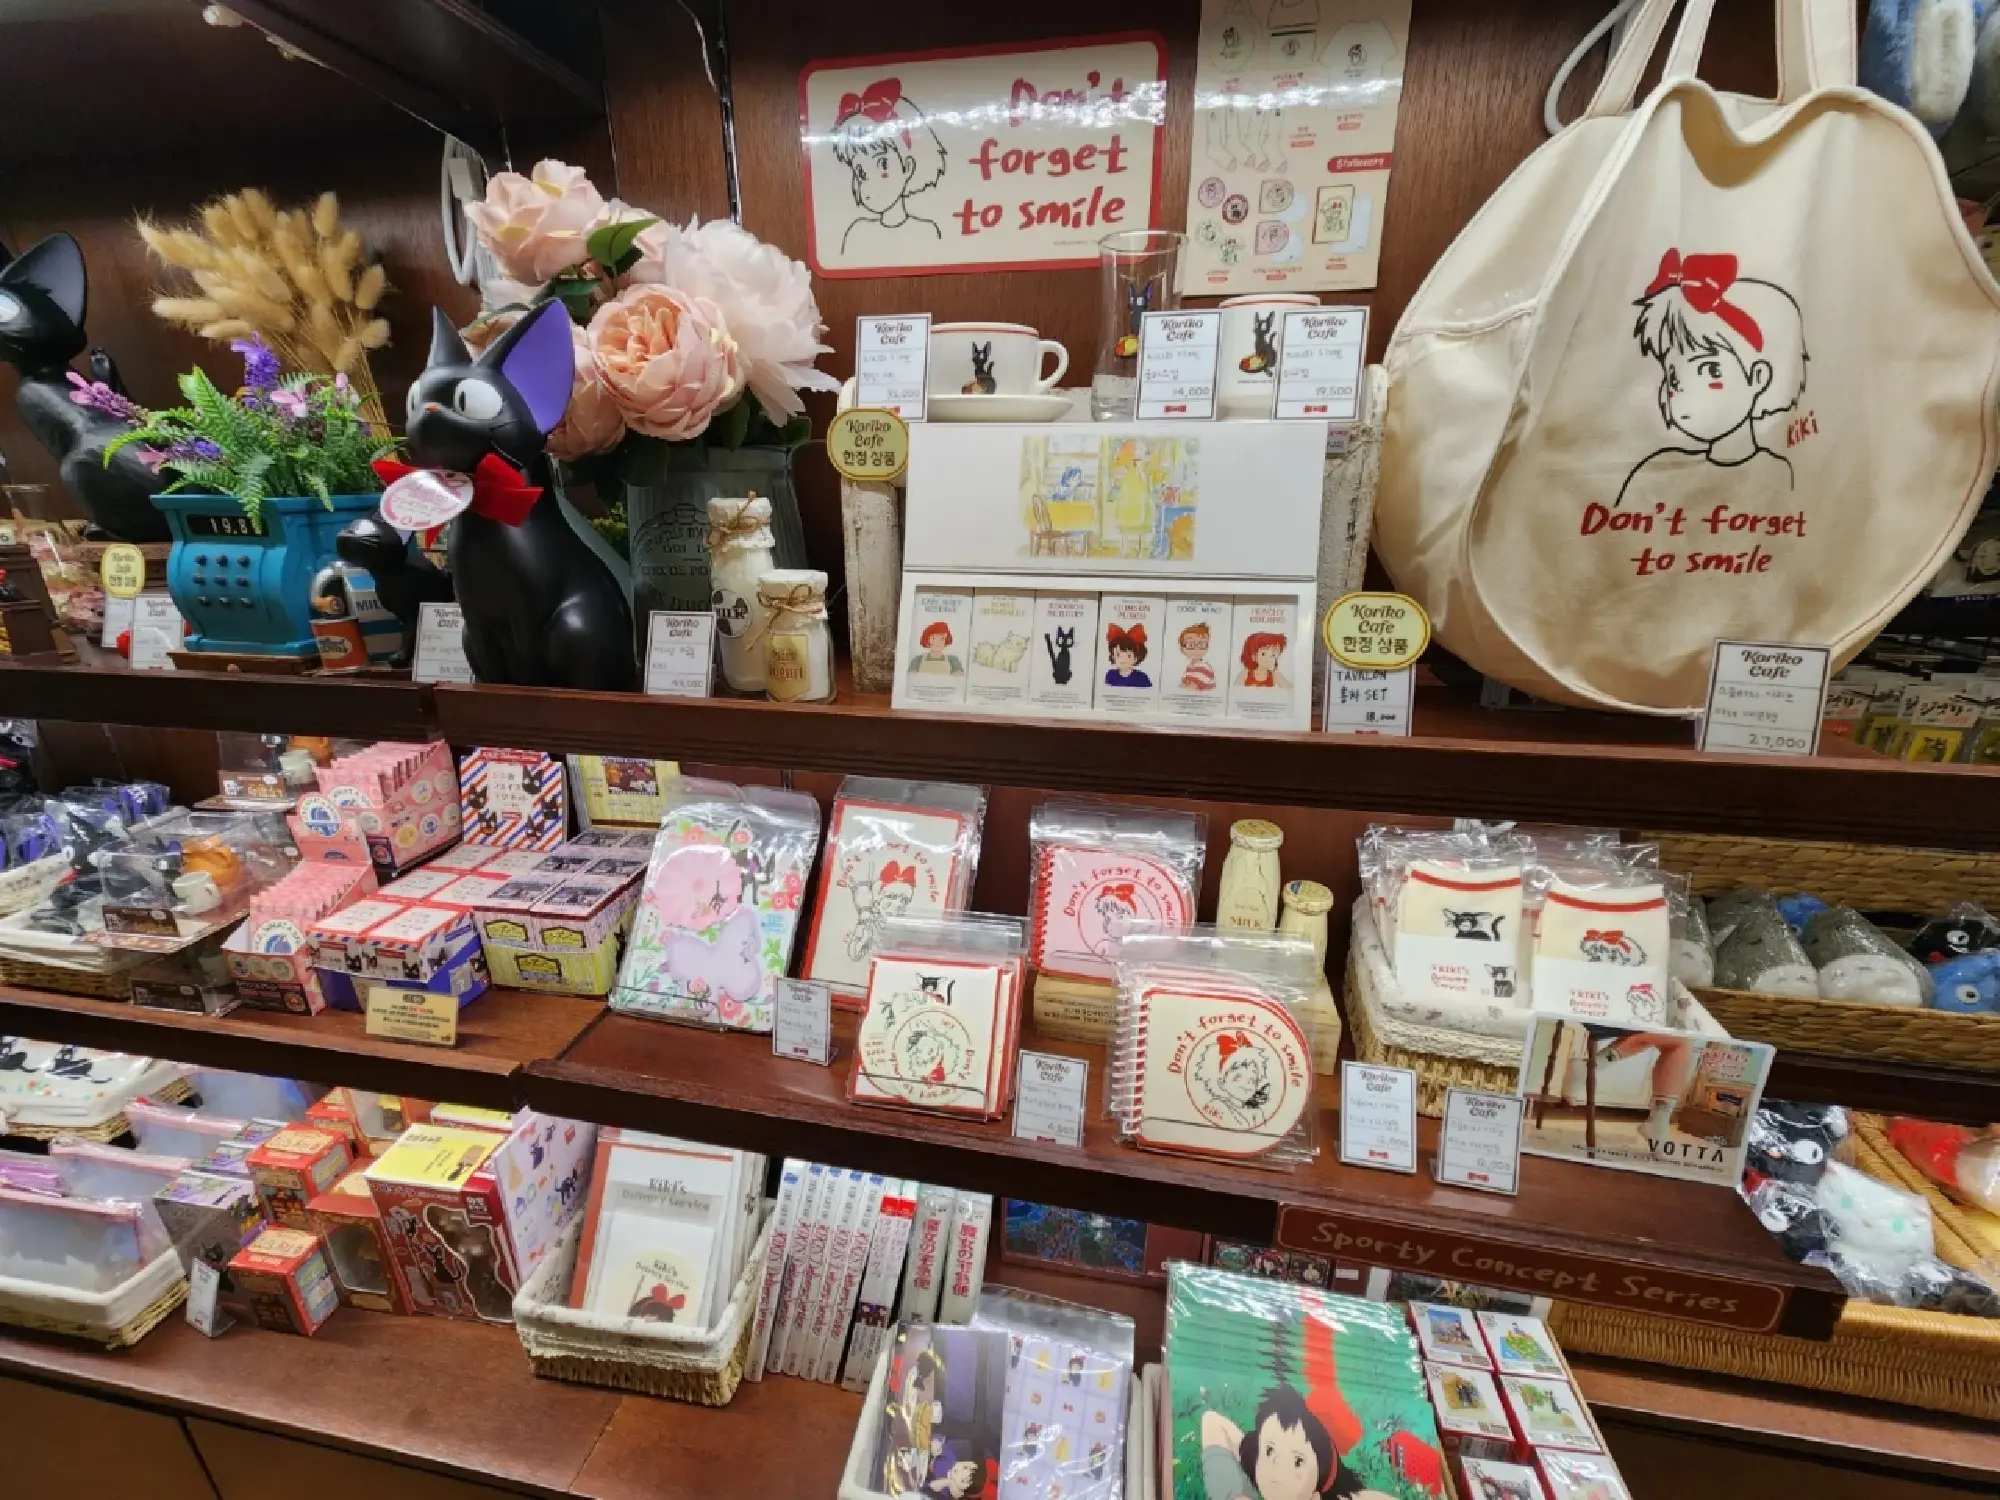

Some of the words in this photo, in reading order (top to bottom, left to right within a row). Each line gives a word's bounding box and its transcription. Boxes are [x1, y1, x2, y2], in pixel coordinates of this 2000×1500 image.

[1009, 70, 1131, 127] Don't
[968, 134, 1128, 180] forget
[953, 199, 1002, 236] to
[1019, 186, 1125, 230] smile
[845, 419, 892, 433] Koriko
[855, 433, 884, 449] Cafe
[842, 450, 867, 467] 한정
[870, 450, 896, 467] 상품
[1581, 503, 1687, 536] Don't
[1702, 505, 1807, 537] forget
[1631, 548, 1675, 576] to
[1686, 545, 1772, 574] smile
[1350, 605, 1405, 620] Koriko
[1358, 620, 1395, 636] Cafe
[1342, 636, 1372, 653] 한정
[1378, 636, 1408, 655] 상품
[1741, 650, 1803, 665] Koriko
[1748, 665, 1791, 679] Cafe
[1364, 687, 1388, 702] SET
[1749, 733, 1806, 749] 27,000
[1063, 880, 1088, 917] Don't
[1092, 867, 1142, 880] forget
[1167, 1030, 1197, 1074] Don't
[1198, 1013, 1257, 1030] forget
[1264, 1024, 1282, 1040] to
[1281, 1043, 1303, 1088] smile
[1312, 1222, 1437, 1265] Sporty
[1451, 1247, 1600, 1293] Concept
[1615, 1275, 1740, 1314] Series
